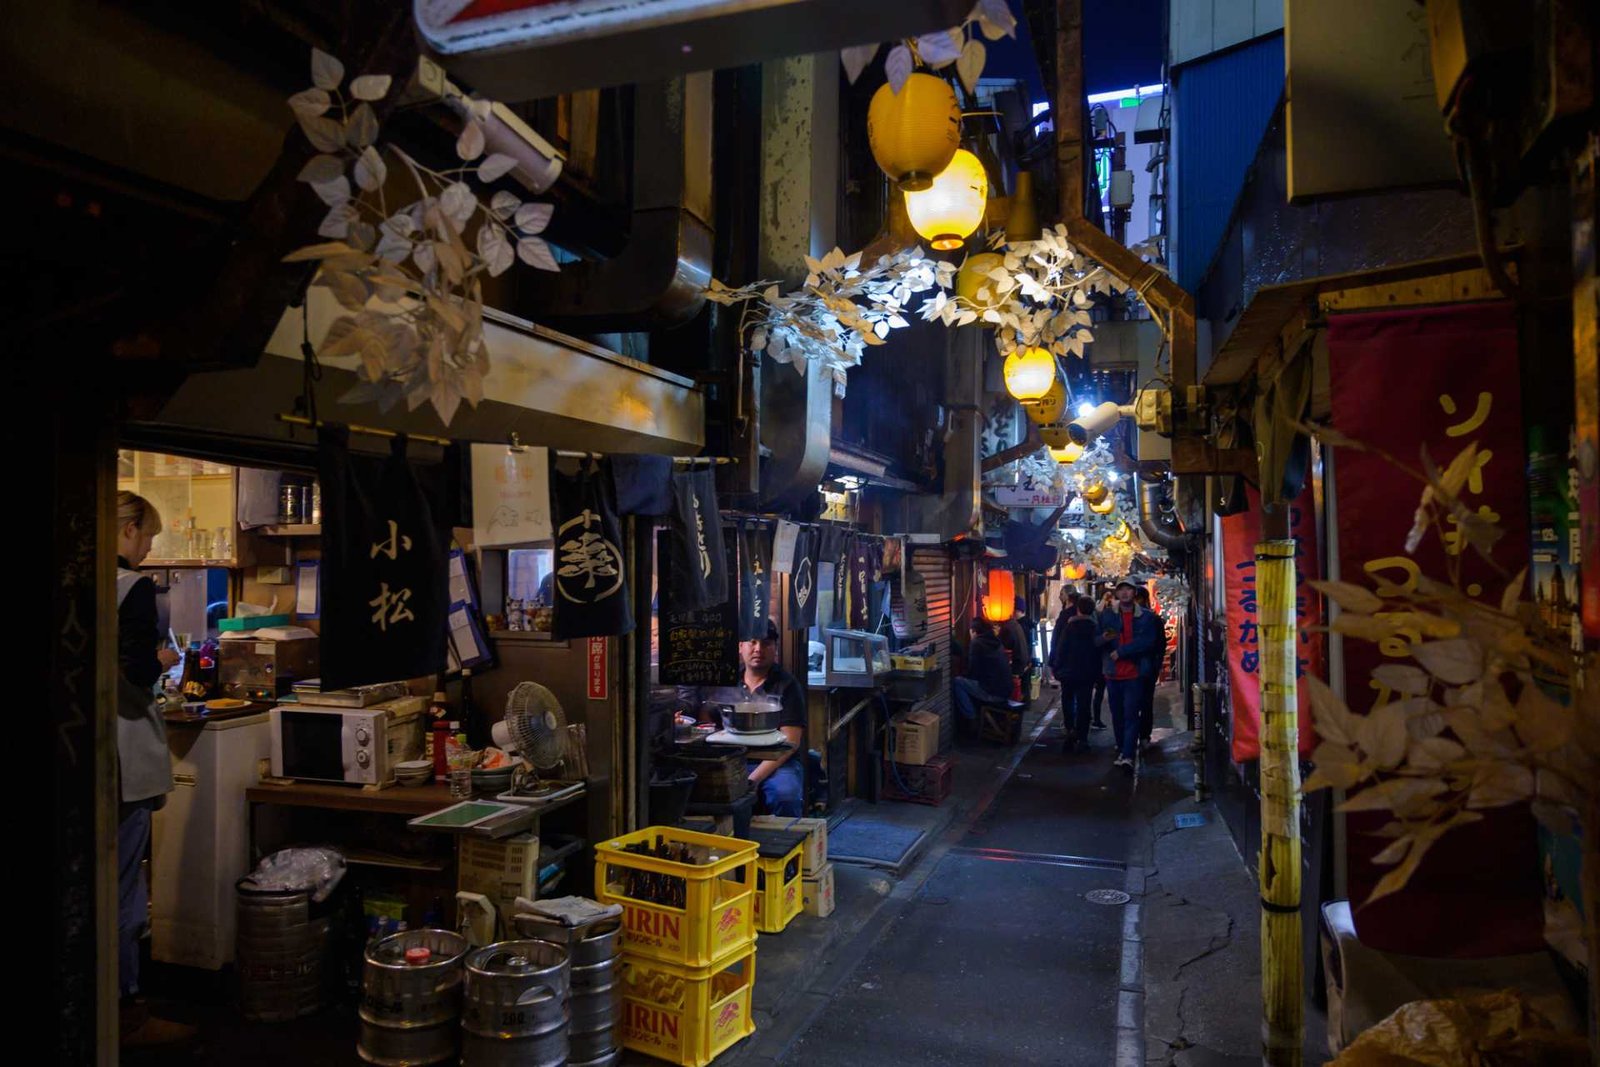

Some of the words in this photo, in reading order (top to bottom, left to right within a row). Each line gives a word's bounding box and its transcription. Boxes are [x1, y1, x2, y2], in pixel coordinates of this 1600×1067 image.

[368, 519, 416, 633] 小松
[626, 906, 680, 941] IRIN
[625, 1004, 678, 1041] IRIN
